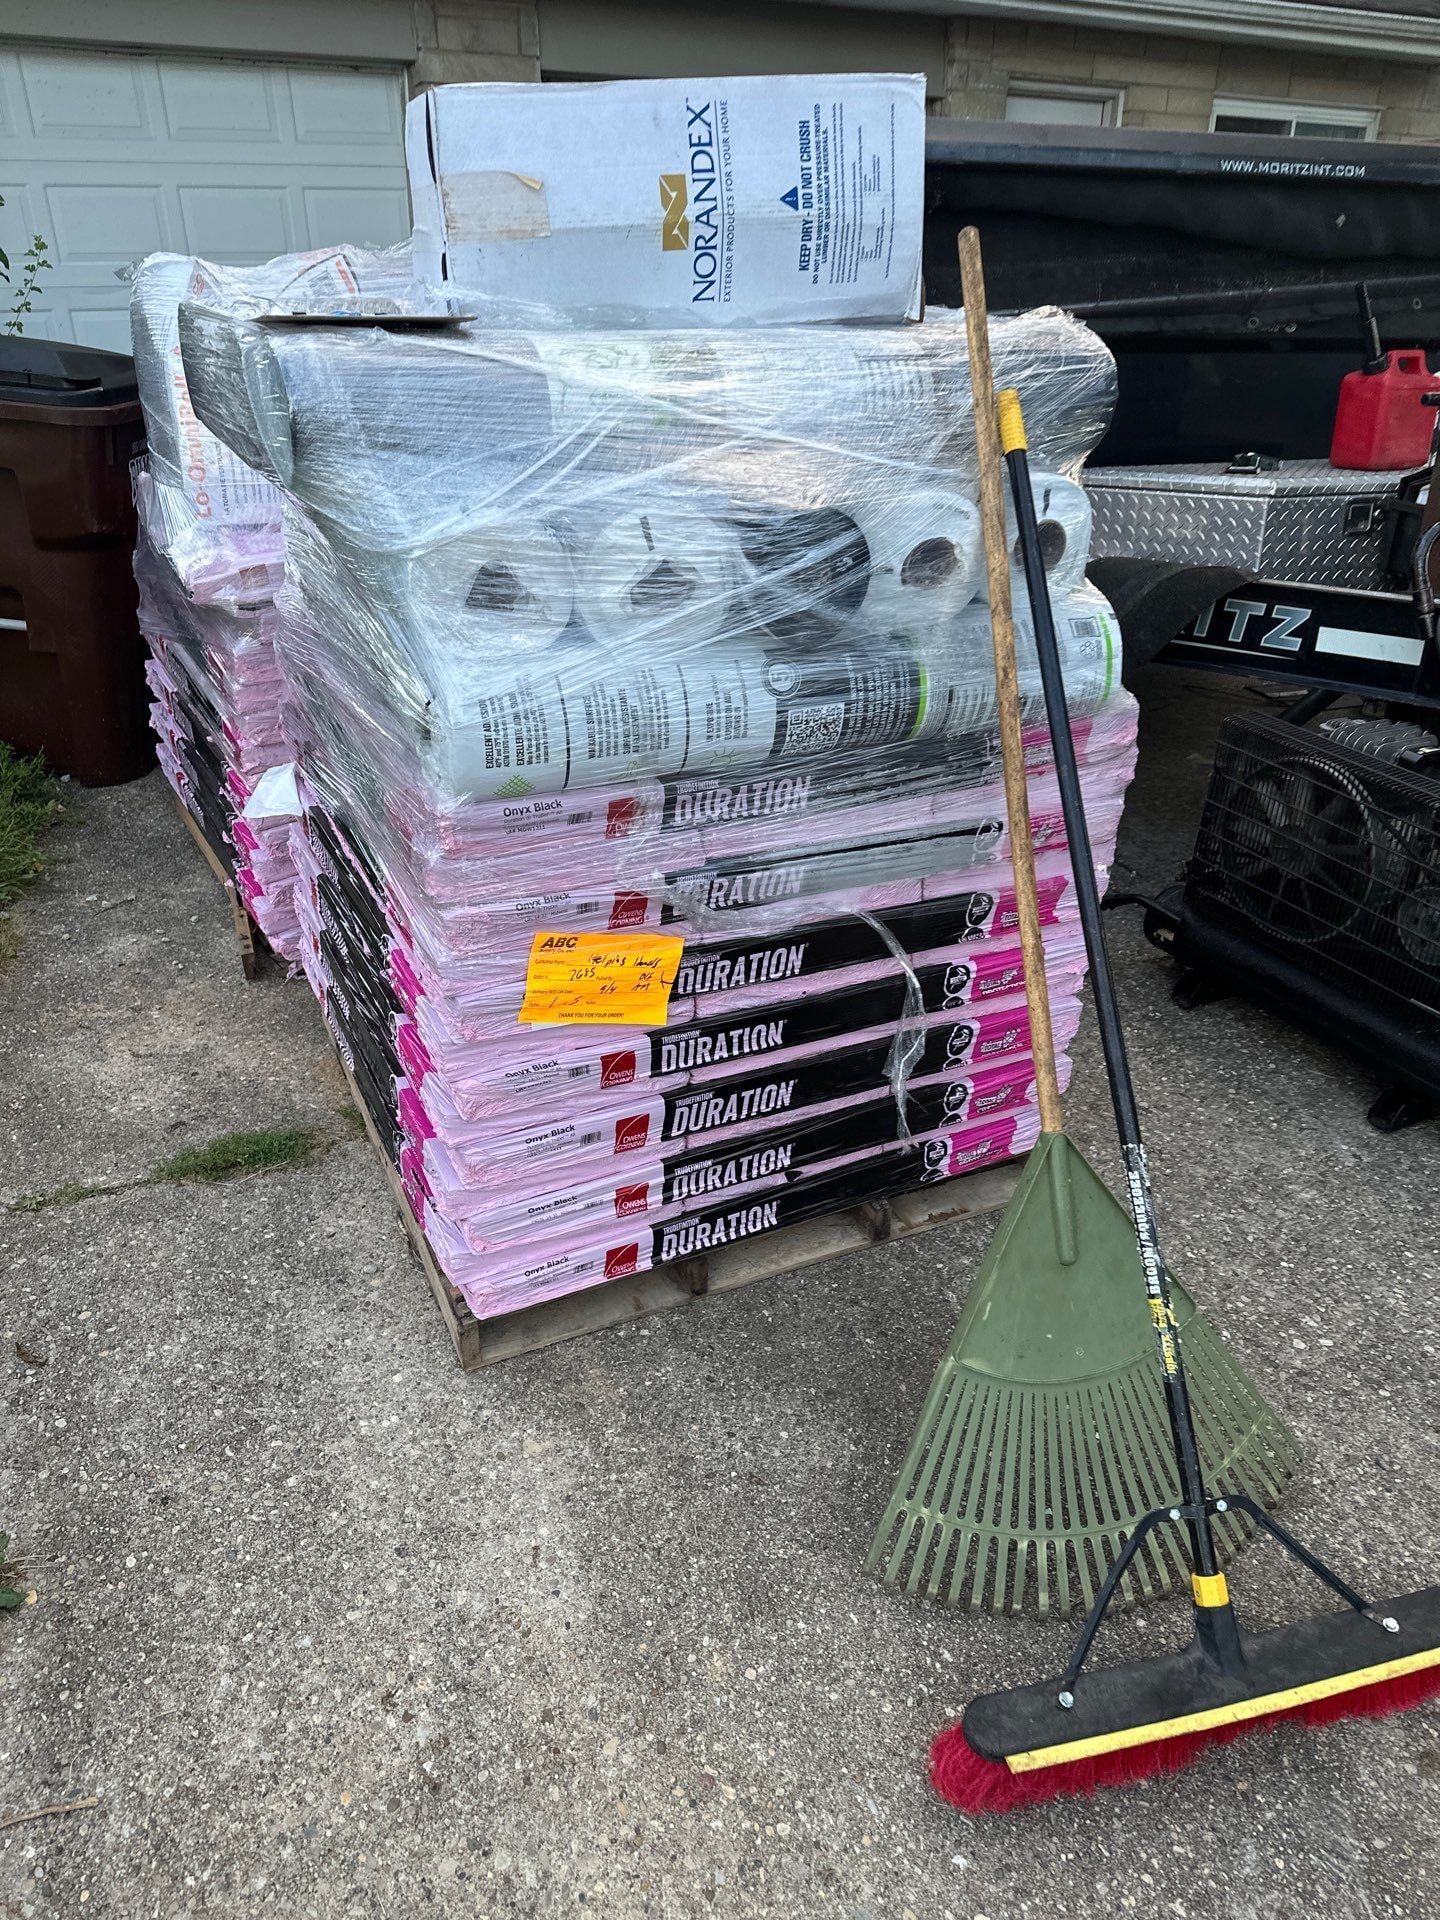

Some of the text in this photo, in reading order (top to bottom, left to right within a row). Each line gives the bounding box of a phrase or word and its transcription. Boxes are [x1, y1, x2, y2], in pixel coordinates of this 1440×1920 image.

[799, 120, 811, 162] CRUSH
[813, 103, 822, 182] PRESSURE-TREATED
[801, 166, 813, 189] NOT
[1220, 159, 1366, 177] WWW.MORITZINT.COM
[686, 101, 719, 302] NORANDEX
[719, 99, 735, 302] EXTERIOR PRODUCTS FOR YOUR HOME
[801, 192, 813, 209] DO
[816, 183, 824, 204] OVER
[800, 219, 813, 242] DRY
[816, 206, 824, 241] DIRECTLY
[823, 221, 830, 233] OR
[799, 244, 810, 272] KEEP
[814, 242, 822, 257] USE
[821, 234, 829, 264] LUMBER
[812, 275, 819, 285] DO
[1190, 598, 1312, 651] ITZ
[508, 692, 522, 726] ADHSION
[478, 699, 494, 769] EXCELLENT ADESION
[503, 799, 563, 819] Onyx Black
[674, 775, 812, 827] DURATION
[709, 867, 805, 909] RATION
[515, 892, 572, 913] Onyx Black
[618, 909, 644, 919] OWENS
[541, 936, 578, 949] ABC
[677, 944, 805, 995] DURATION
[661, 1020, 784, 1073] DURATION
[505, 1060, 559, 1079] Onyx Black
[609, 1069, 634, 1080] OWENS
[671, 1080, 795, 1137] DURATION
[675, 1092, 713, 1108] TRUDEFINITION
[525, 1124, 576, 1145] Onyx Black
[623, 1132, 646, 1144] OWENS
[617, 1140, 646, 1152] CORNING
[672, 1144, 792, 1202] DURATION
[674, 1160, 713, 1176] TRUDEFINITION
[527, 1203, 552, 1215] Onyx
[554, 1195, 578, 1207] Black
[622, 1198, 646, 1210] OWENS
[661, 1201, 778, 1262] DURATION
[663, 1217, 700, 1235] TRUDEFINITION
[524, 1265, 545, 1278] Onyx
[547, 1256, 569, 1269] Black
